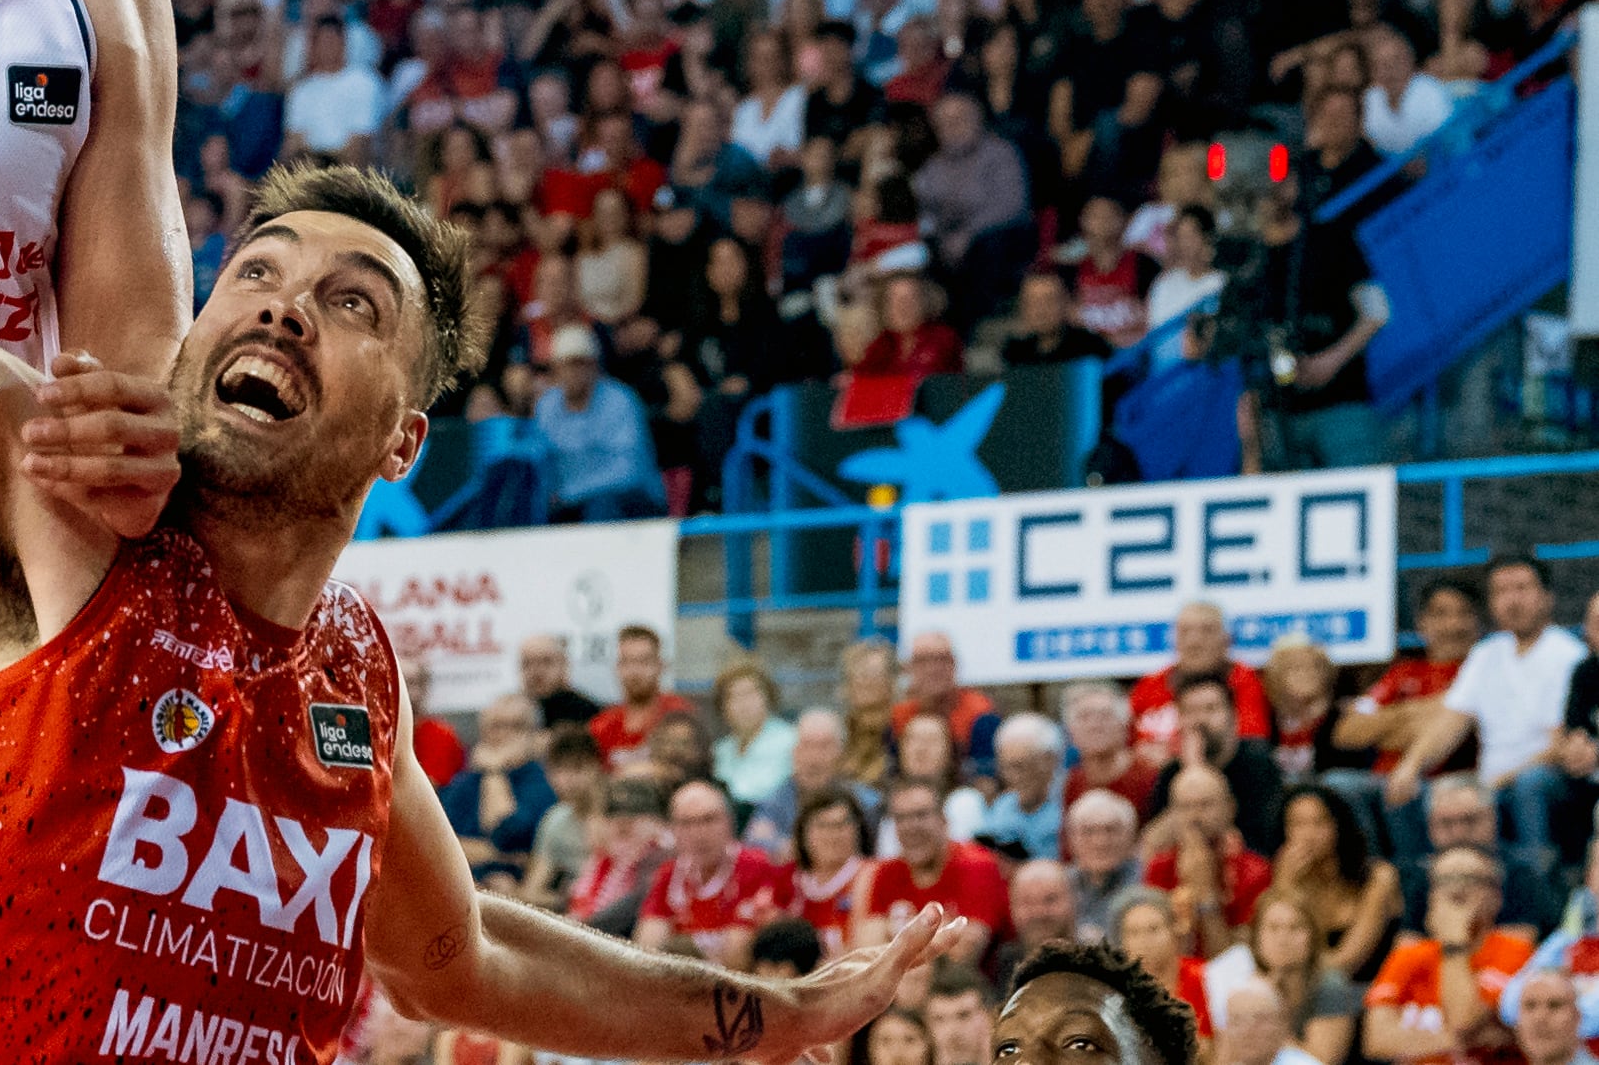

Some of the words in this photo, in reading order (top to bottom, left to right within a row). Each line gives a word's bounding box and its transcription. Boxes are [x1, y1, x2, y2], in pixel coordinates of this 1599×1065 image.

[15, 81, 45, 102] liga
[15, 100, 75, 119] endesa
[319, 722, 347, 742] liga
[97, 766, 375, 950] BAXI
[83, 898, 347, 1005] CLIMATIZACIÓN
